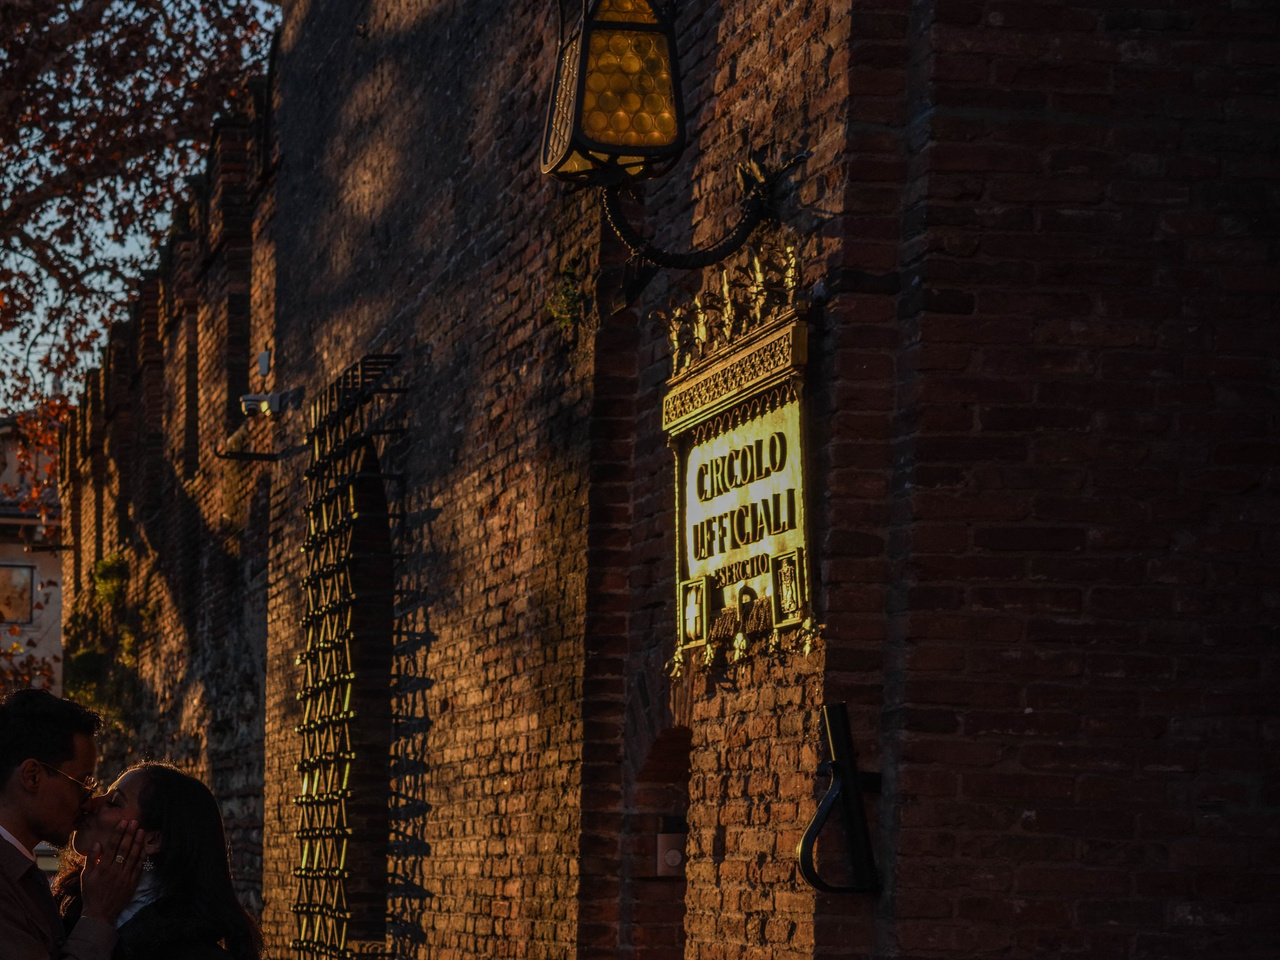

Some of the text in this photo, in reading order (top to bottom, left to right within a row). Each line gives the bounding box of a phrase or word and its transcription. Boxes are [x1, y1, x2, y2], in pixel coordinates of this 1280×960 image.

[696, 432, 787, 502] CIRCOLO
[693, 489, 797, 561] UFFICIALI
[714, 553, 770, 589] ESERCITO
